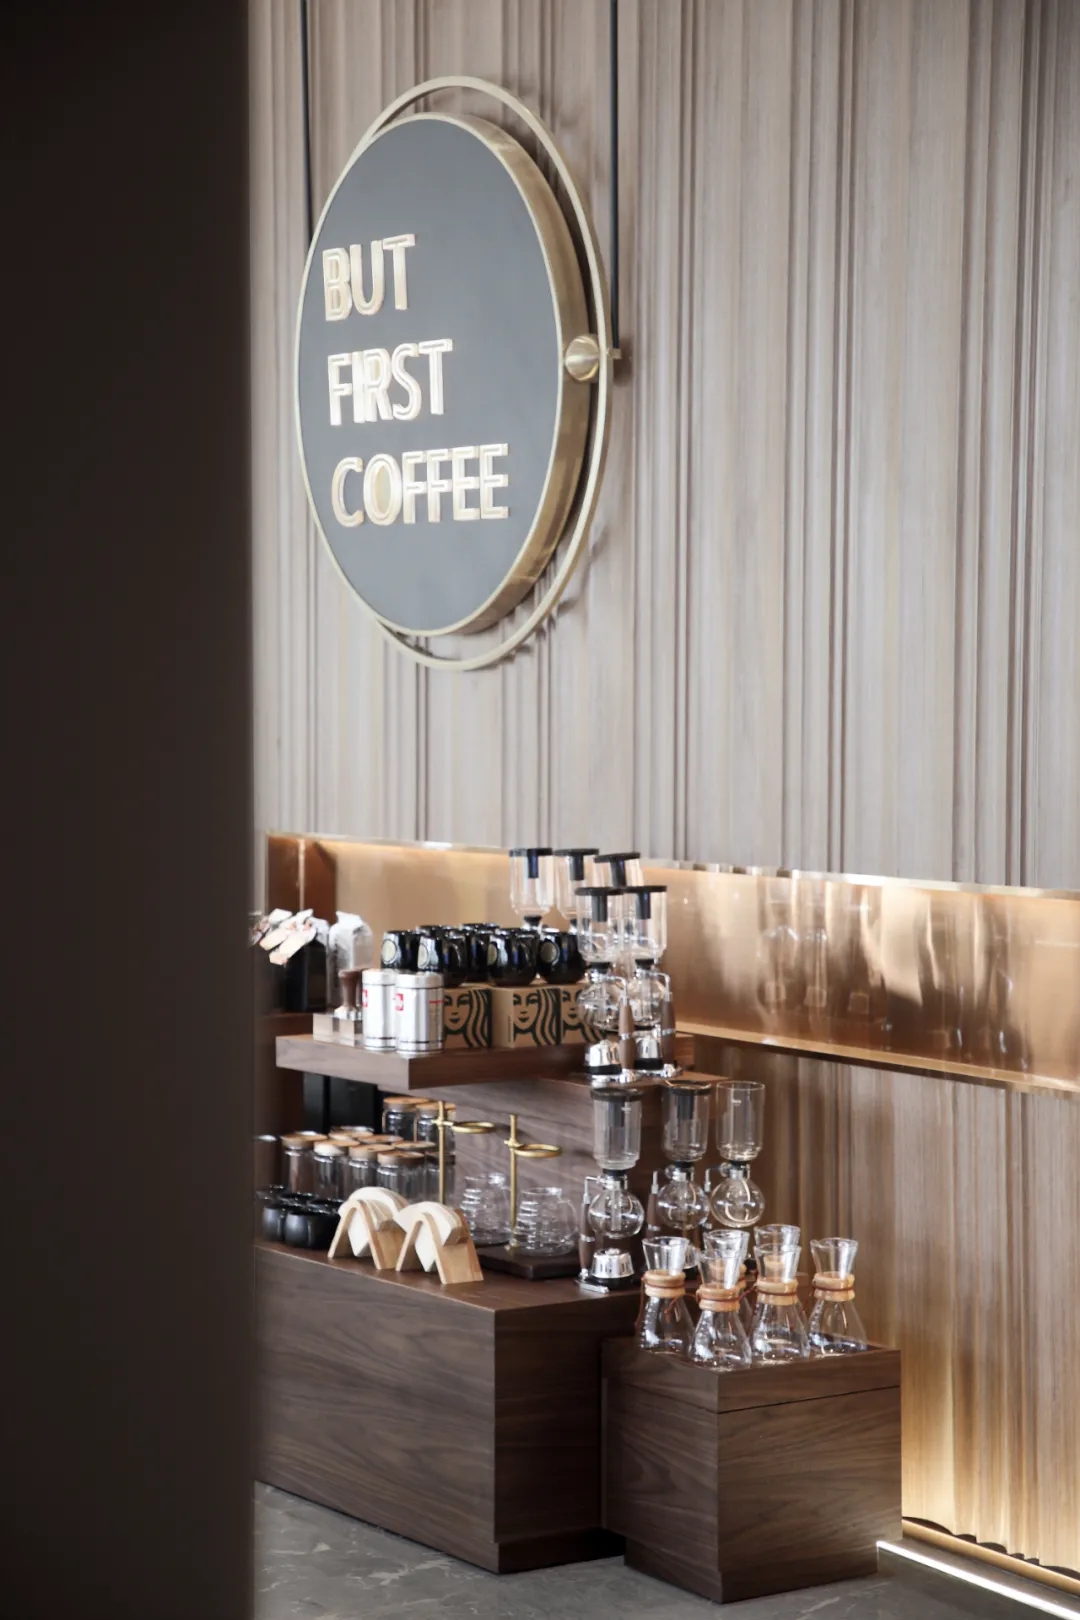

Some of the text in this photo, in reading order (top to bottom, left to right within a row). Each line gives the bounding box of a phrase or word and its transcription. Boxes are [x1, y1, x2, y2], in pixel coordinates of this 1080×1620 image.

[323, 233, 416, 321] BUT
[327, 338, 453, 425] FIRST
[332, 442, 509, 527] COFFEE
